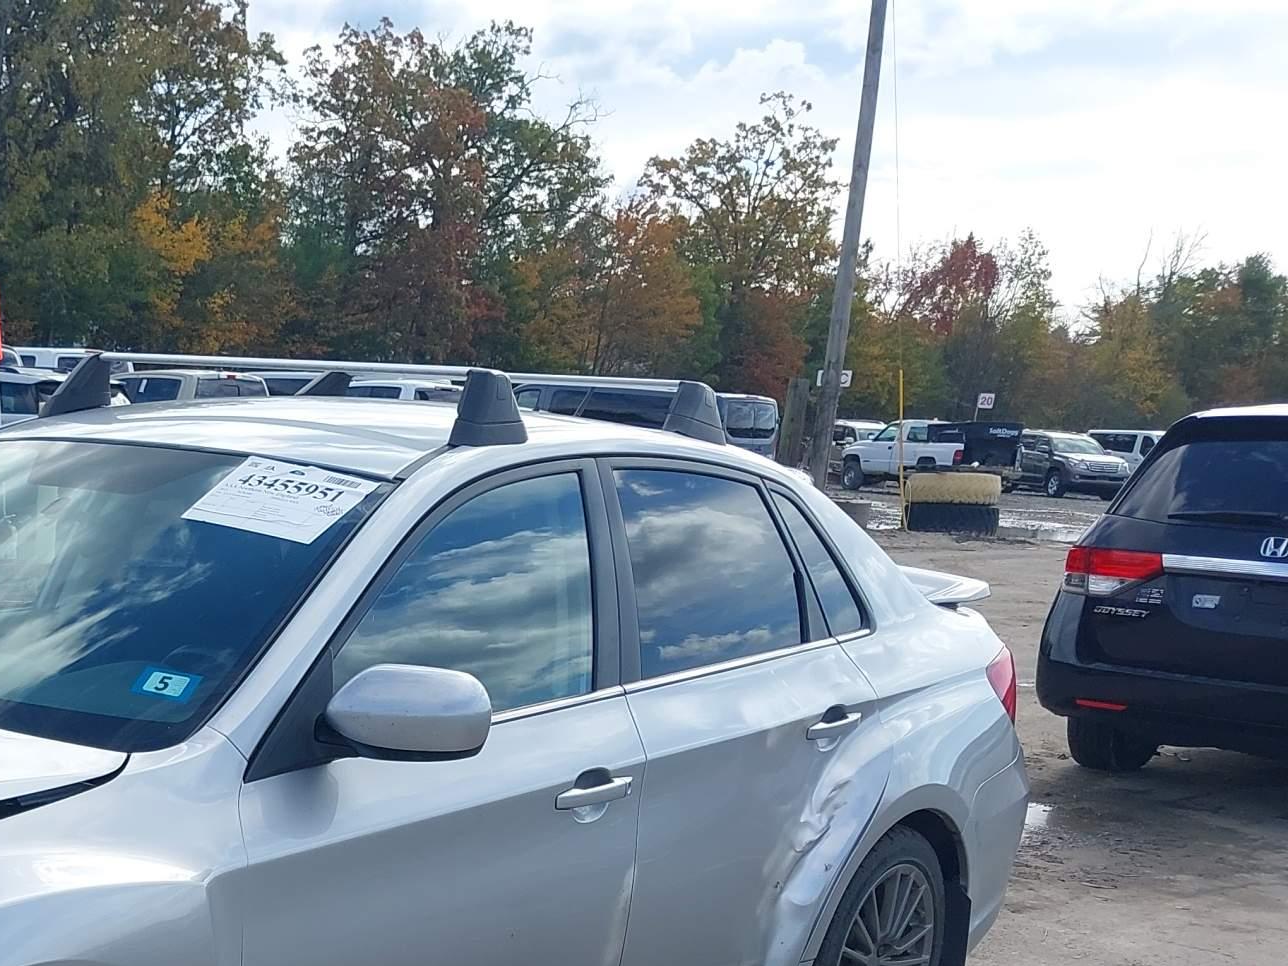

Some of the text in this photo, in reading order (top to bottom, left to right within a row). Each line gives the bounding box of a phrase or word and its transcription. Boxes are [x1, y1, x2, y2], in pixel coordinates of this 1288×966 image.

[981, 397, 993, 406] 20
[238, 473, 344, 502] 43455951
[1093, 605, 1150, 618] ODYSSEY
[154, 676, 173, 691] 5
